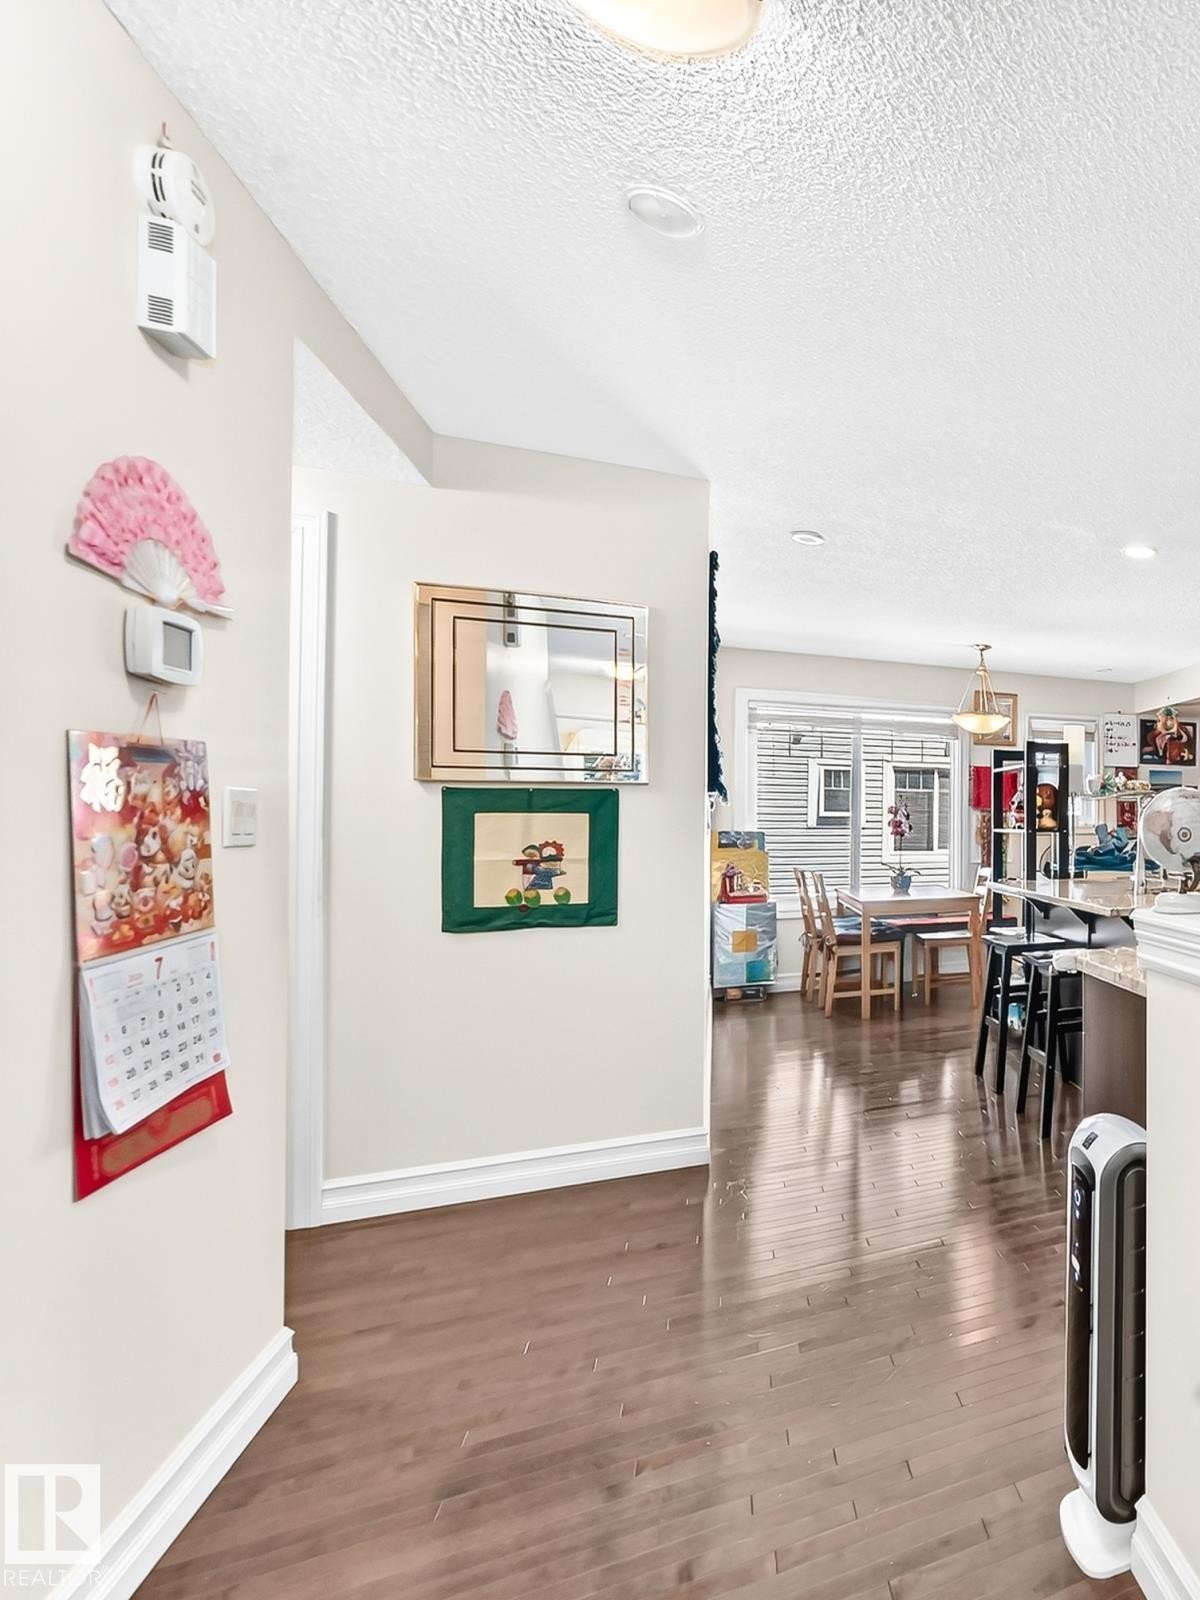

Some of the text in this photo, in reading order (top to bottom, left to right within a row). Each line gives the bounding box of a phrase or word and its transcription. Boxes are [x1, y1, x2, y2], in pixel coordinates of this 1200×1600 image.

[80, 742, 124, 813] 福
[154, 956, 163, 980] 7
[141, 1037, 150, 1048] 14
[158, 1028, 170, 1039] 15
[192, 1014, 200, 1024] 17
